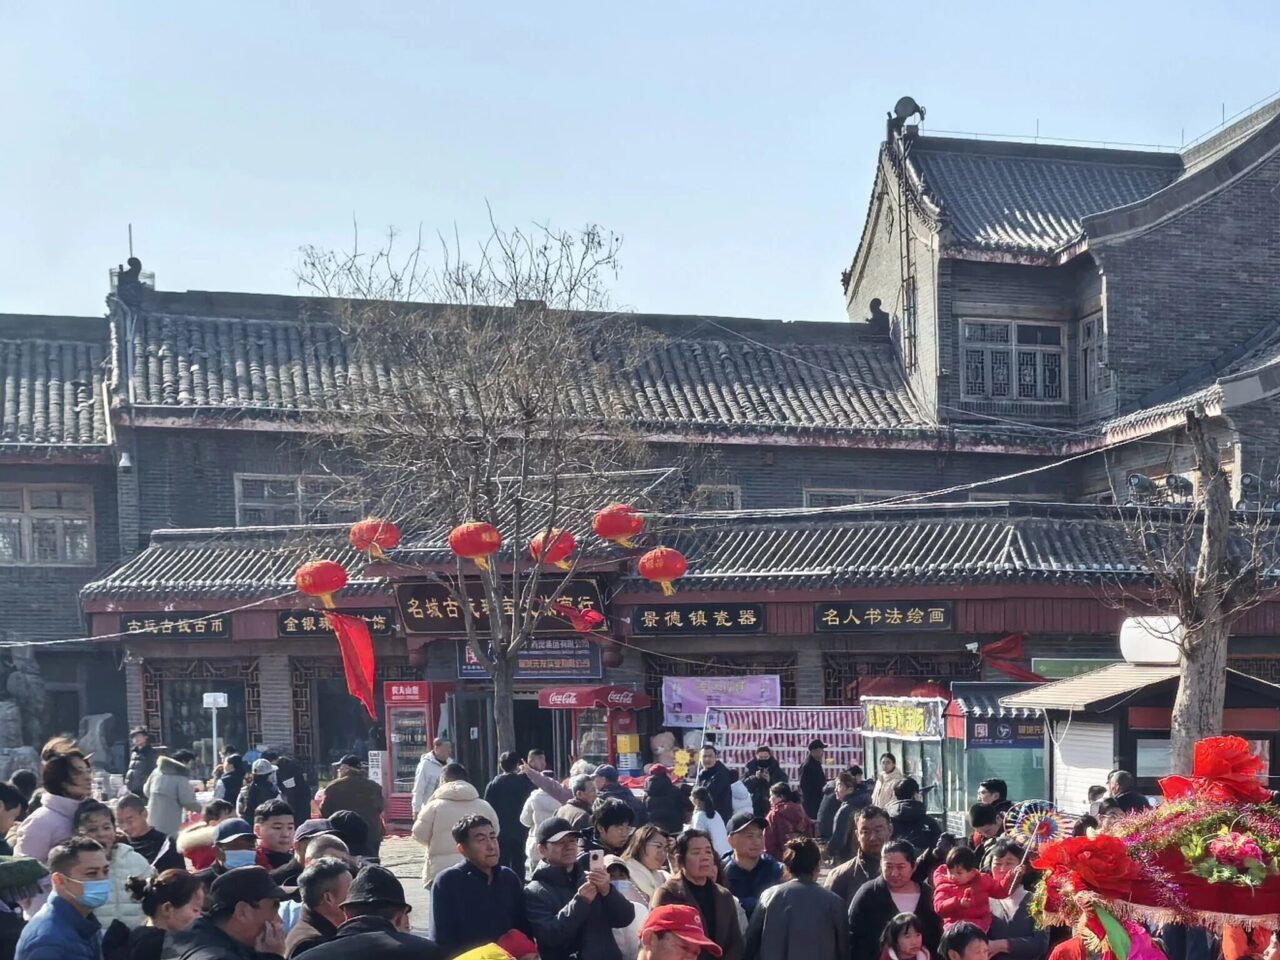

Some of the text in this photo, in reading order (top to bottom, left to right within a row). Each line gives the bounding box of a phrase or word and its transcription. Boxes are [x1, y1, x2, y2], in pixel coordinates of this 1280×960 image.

[284, 615, 387, 631] 金银珠饰
[640, 609, 757, 627] 景德镇瓷器
[822, 607, 946, 626] 名人书法绘画
